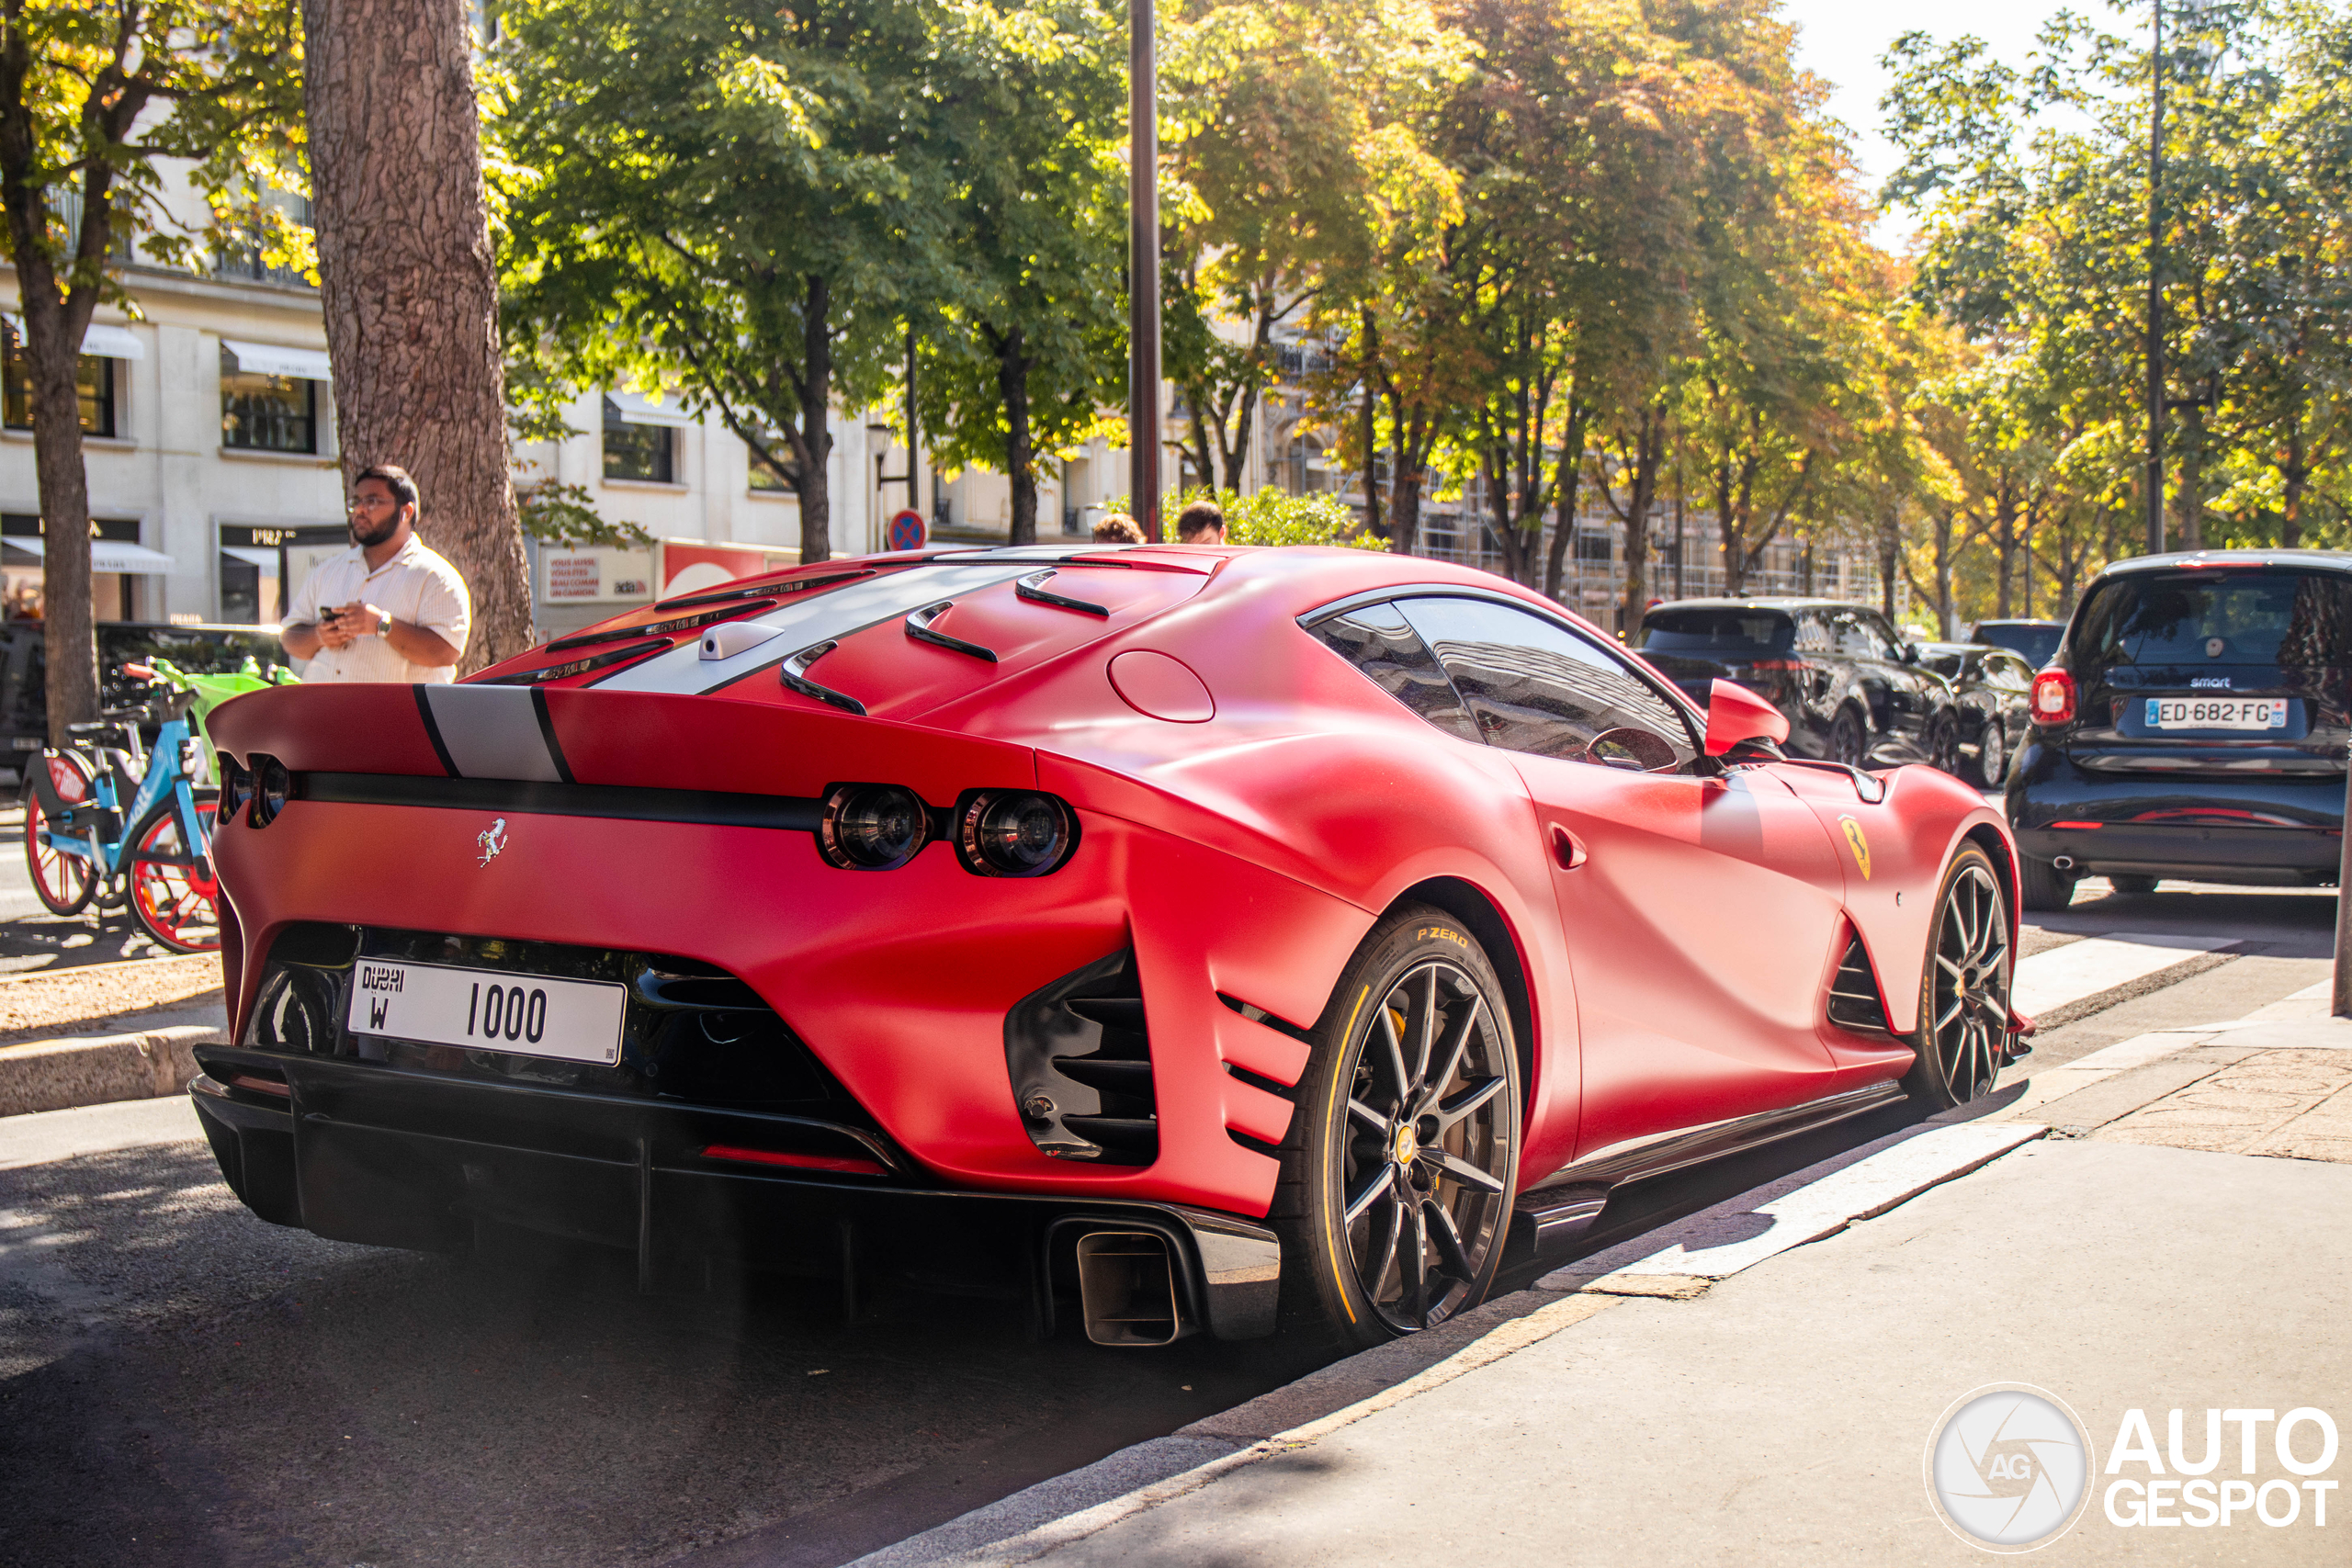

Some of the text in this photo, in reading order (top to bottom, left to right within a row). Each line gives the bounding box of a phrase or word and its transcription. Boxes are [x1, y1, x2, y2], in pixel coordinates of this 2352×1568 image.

[614, 581, 636, 594] ada
[2190, 676, 2232, 688] smart
[2160, 703, 2269, 722] ED-682-FG
[1417, 927, 1468, 949] P ZERO
[369, 996, 389, 1030] W
[468, 982, 548, 1043] 1000
